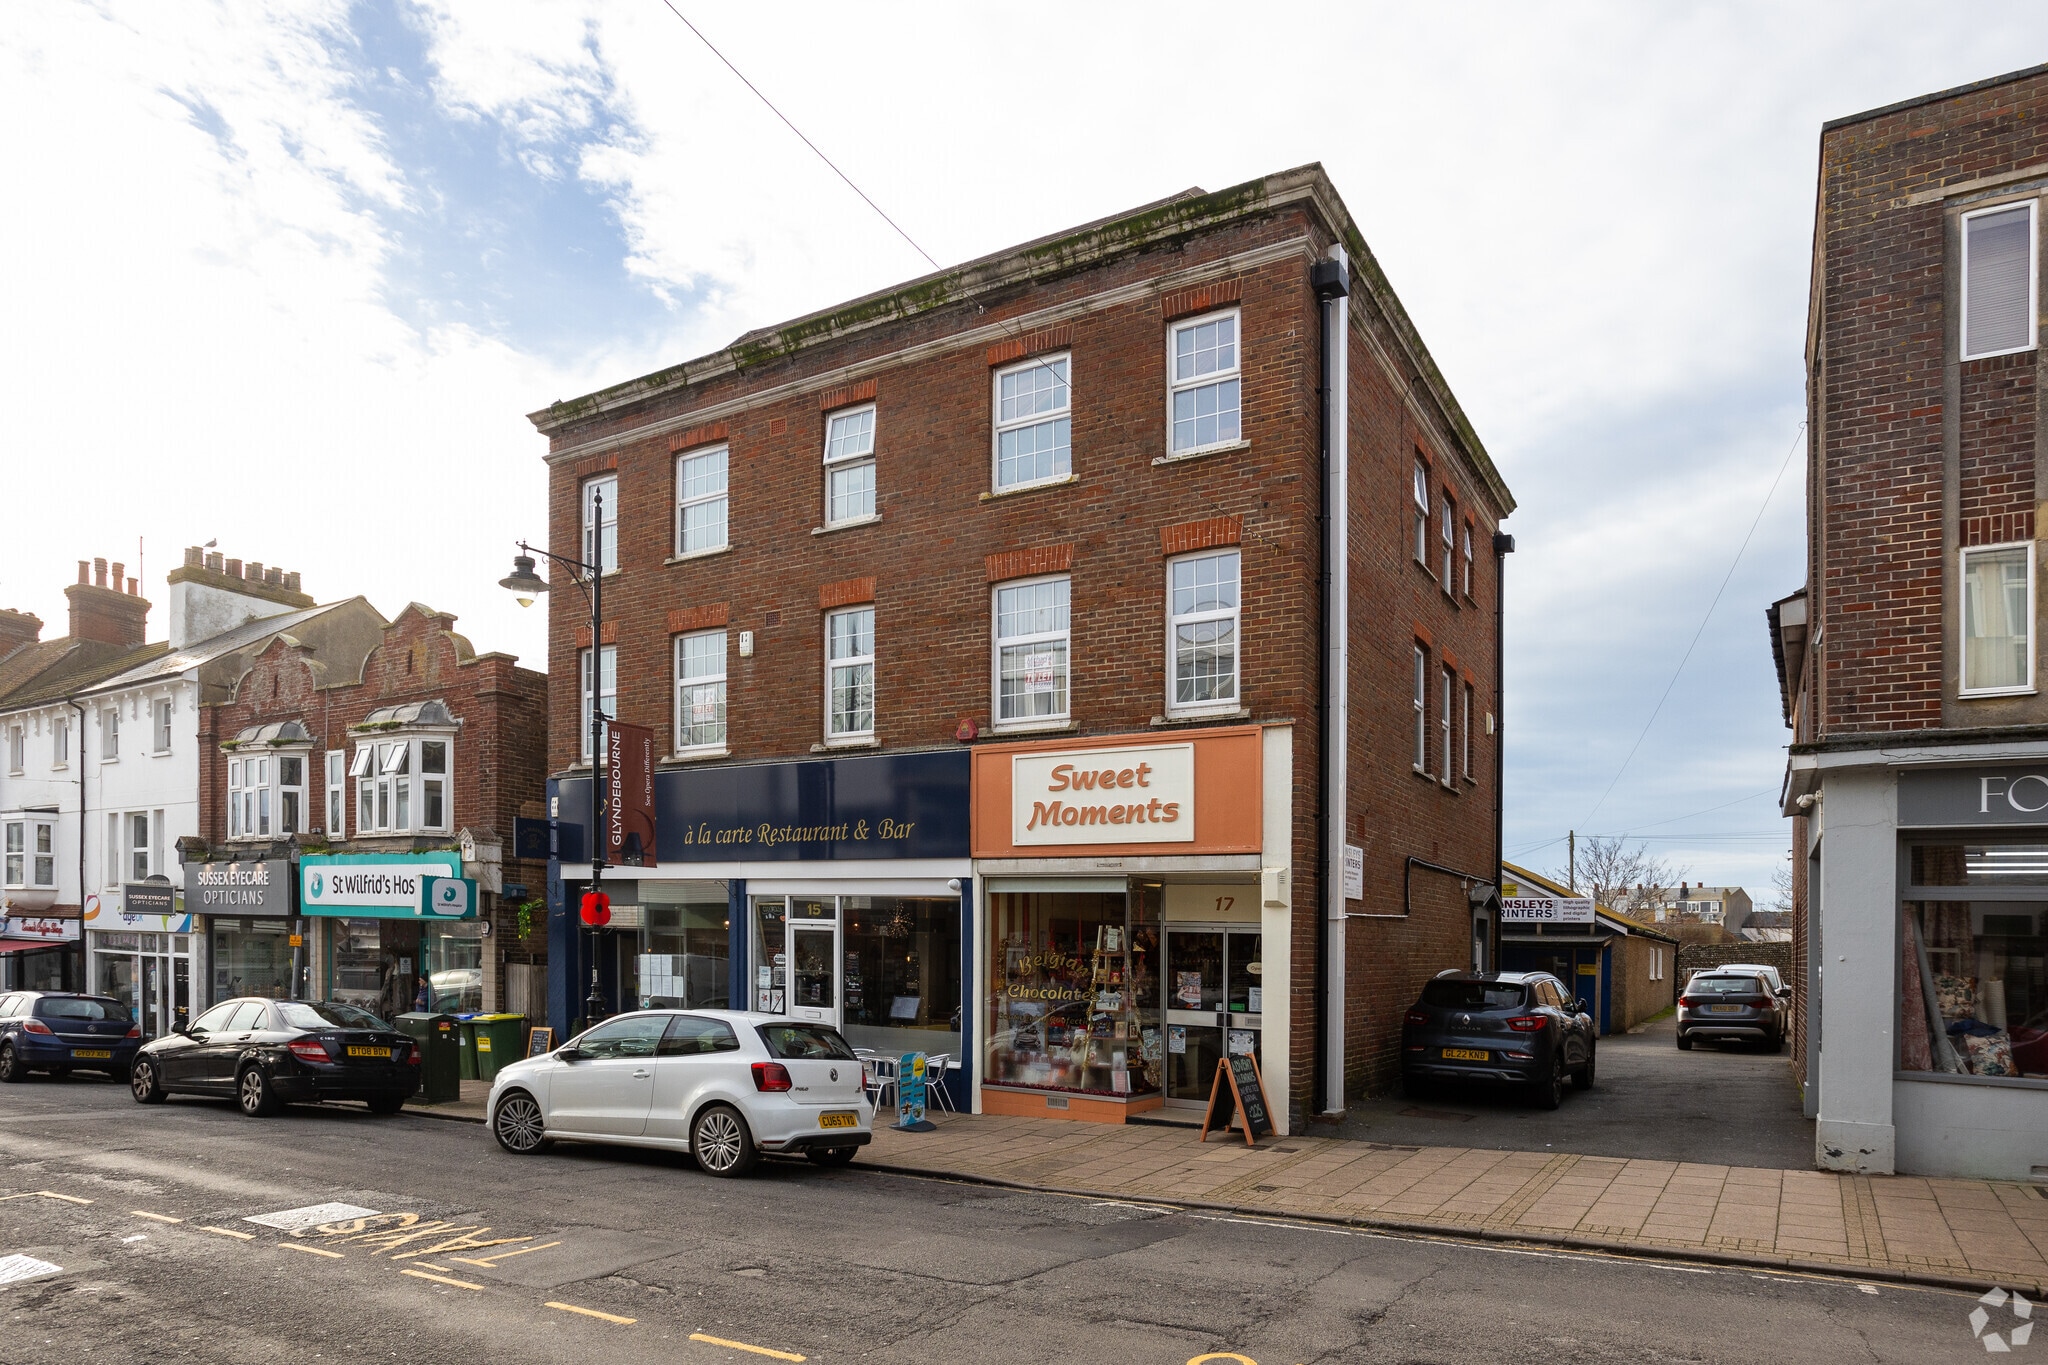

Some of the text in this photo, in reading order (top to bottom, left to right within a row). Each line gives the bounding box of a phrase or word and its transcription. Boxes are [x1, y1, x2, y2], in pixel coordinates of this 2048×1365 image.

[643, 737, 652, 774] Differently
[644, 774, 652, 792] Opera
[1048, 762, 1152, 792] Sweet
[611, 730, 622, 845] GLYNDEBOURNE
[1978, 775, 2048, 813] FO
[1026, 797, 1180, 831] Moments
[684, 818, 916, 847] à la carte Restaurant & Bar
[197, 870, 269, 886] SUSSEX EYECARE
[332, 875, 344, 894] St
[345, 874, 391, 894] Wilfrid's
[203, 890, 264, 905] OPTICIANS
[1215, 896, 1235, 911] 17
[807, 903, 822, 916] 15
[1019, 951, 1089, 977] Belgian
[1007, 983, 1101, 1002] Chocolates
[351, 1047, 372, 1055] BT08
[1445, 1050, 1486, 1059] GL22 KNB
